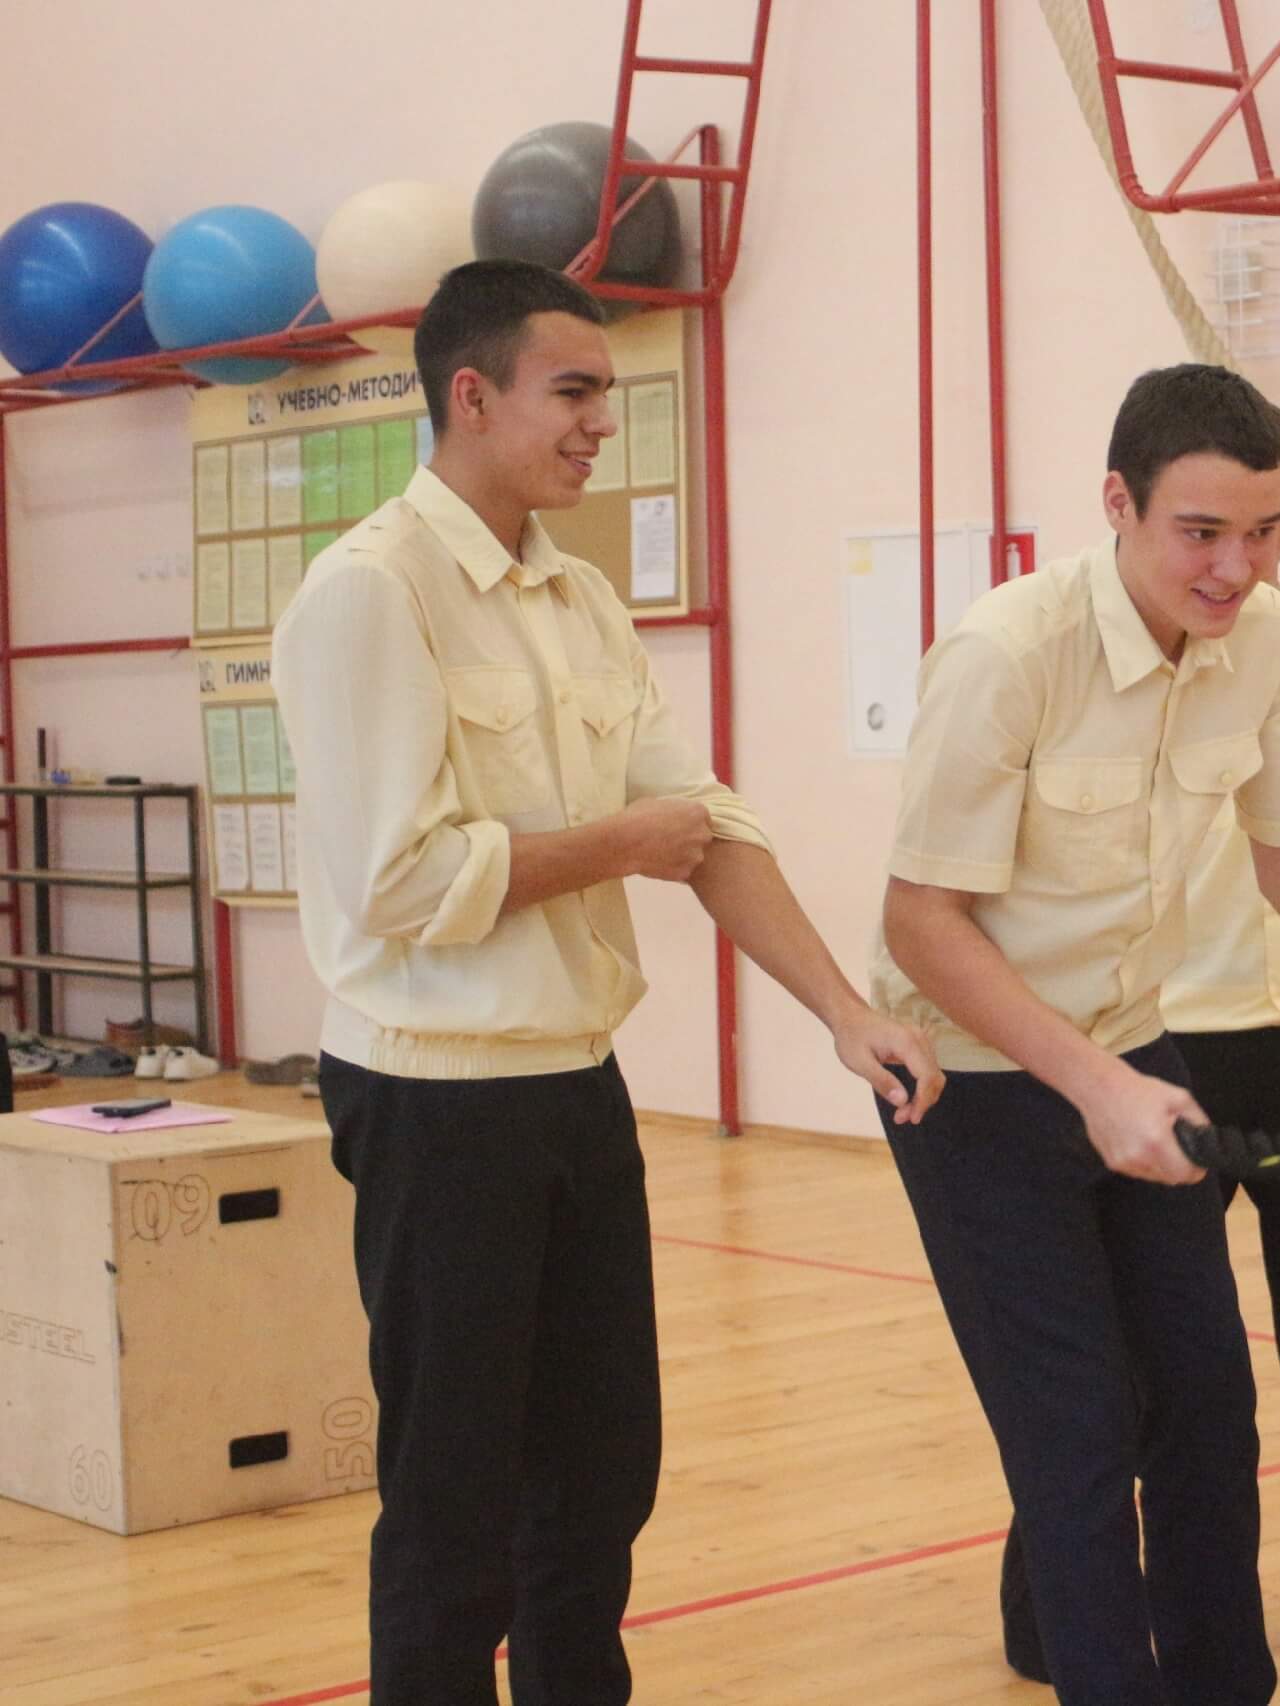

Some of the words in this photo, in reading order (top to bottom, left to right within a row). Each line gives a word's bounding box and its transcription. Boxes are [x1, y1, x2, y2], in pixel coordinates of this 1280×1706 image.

[225, 660, 271, 685] ГИМН
[321, 1396, 376, 1482] 50
[67, 1443, 114, 1512] 60
